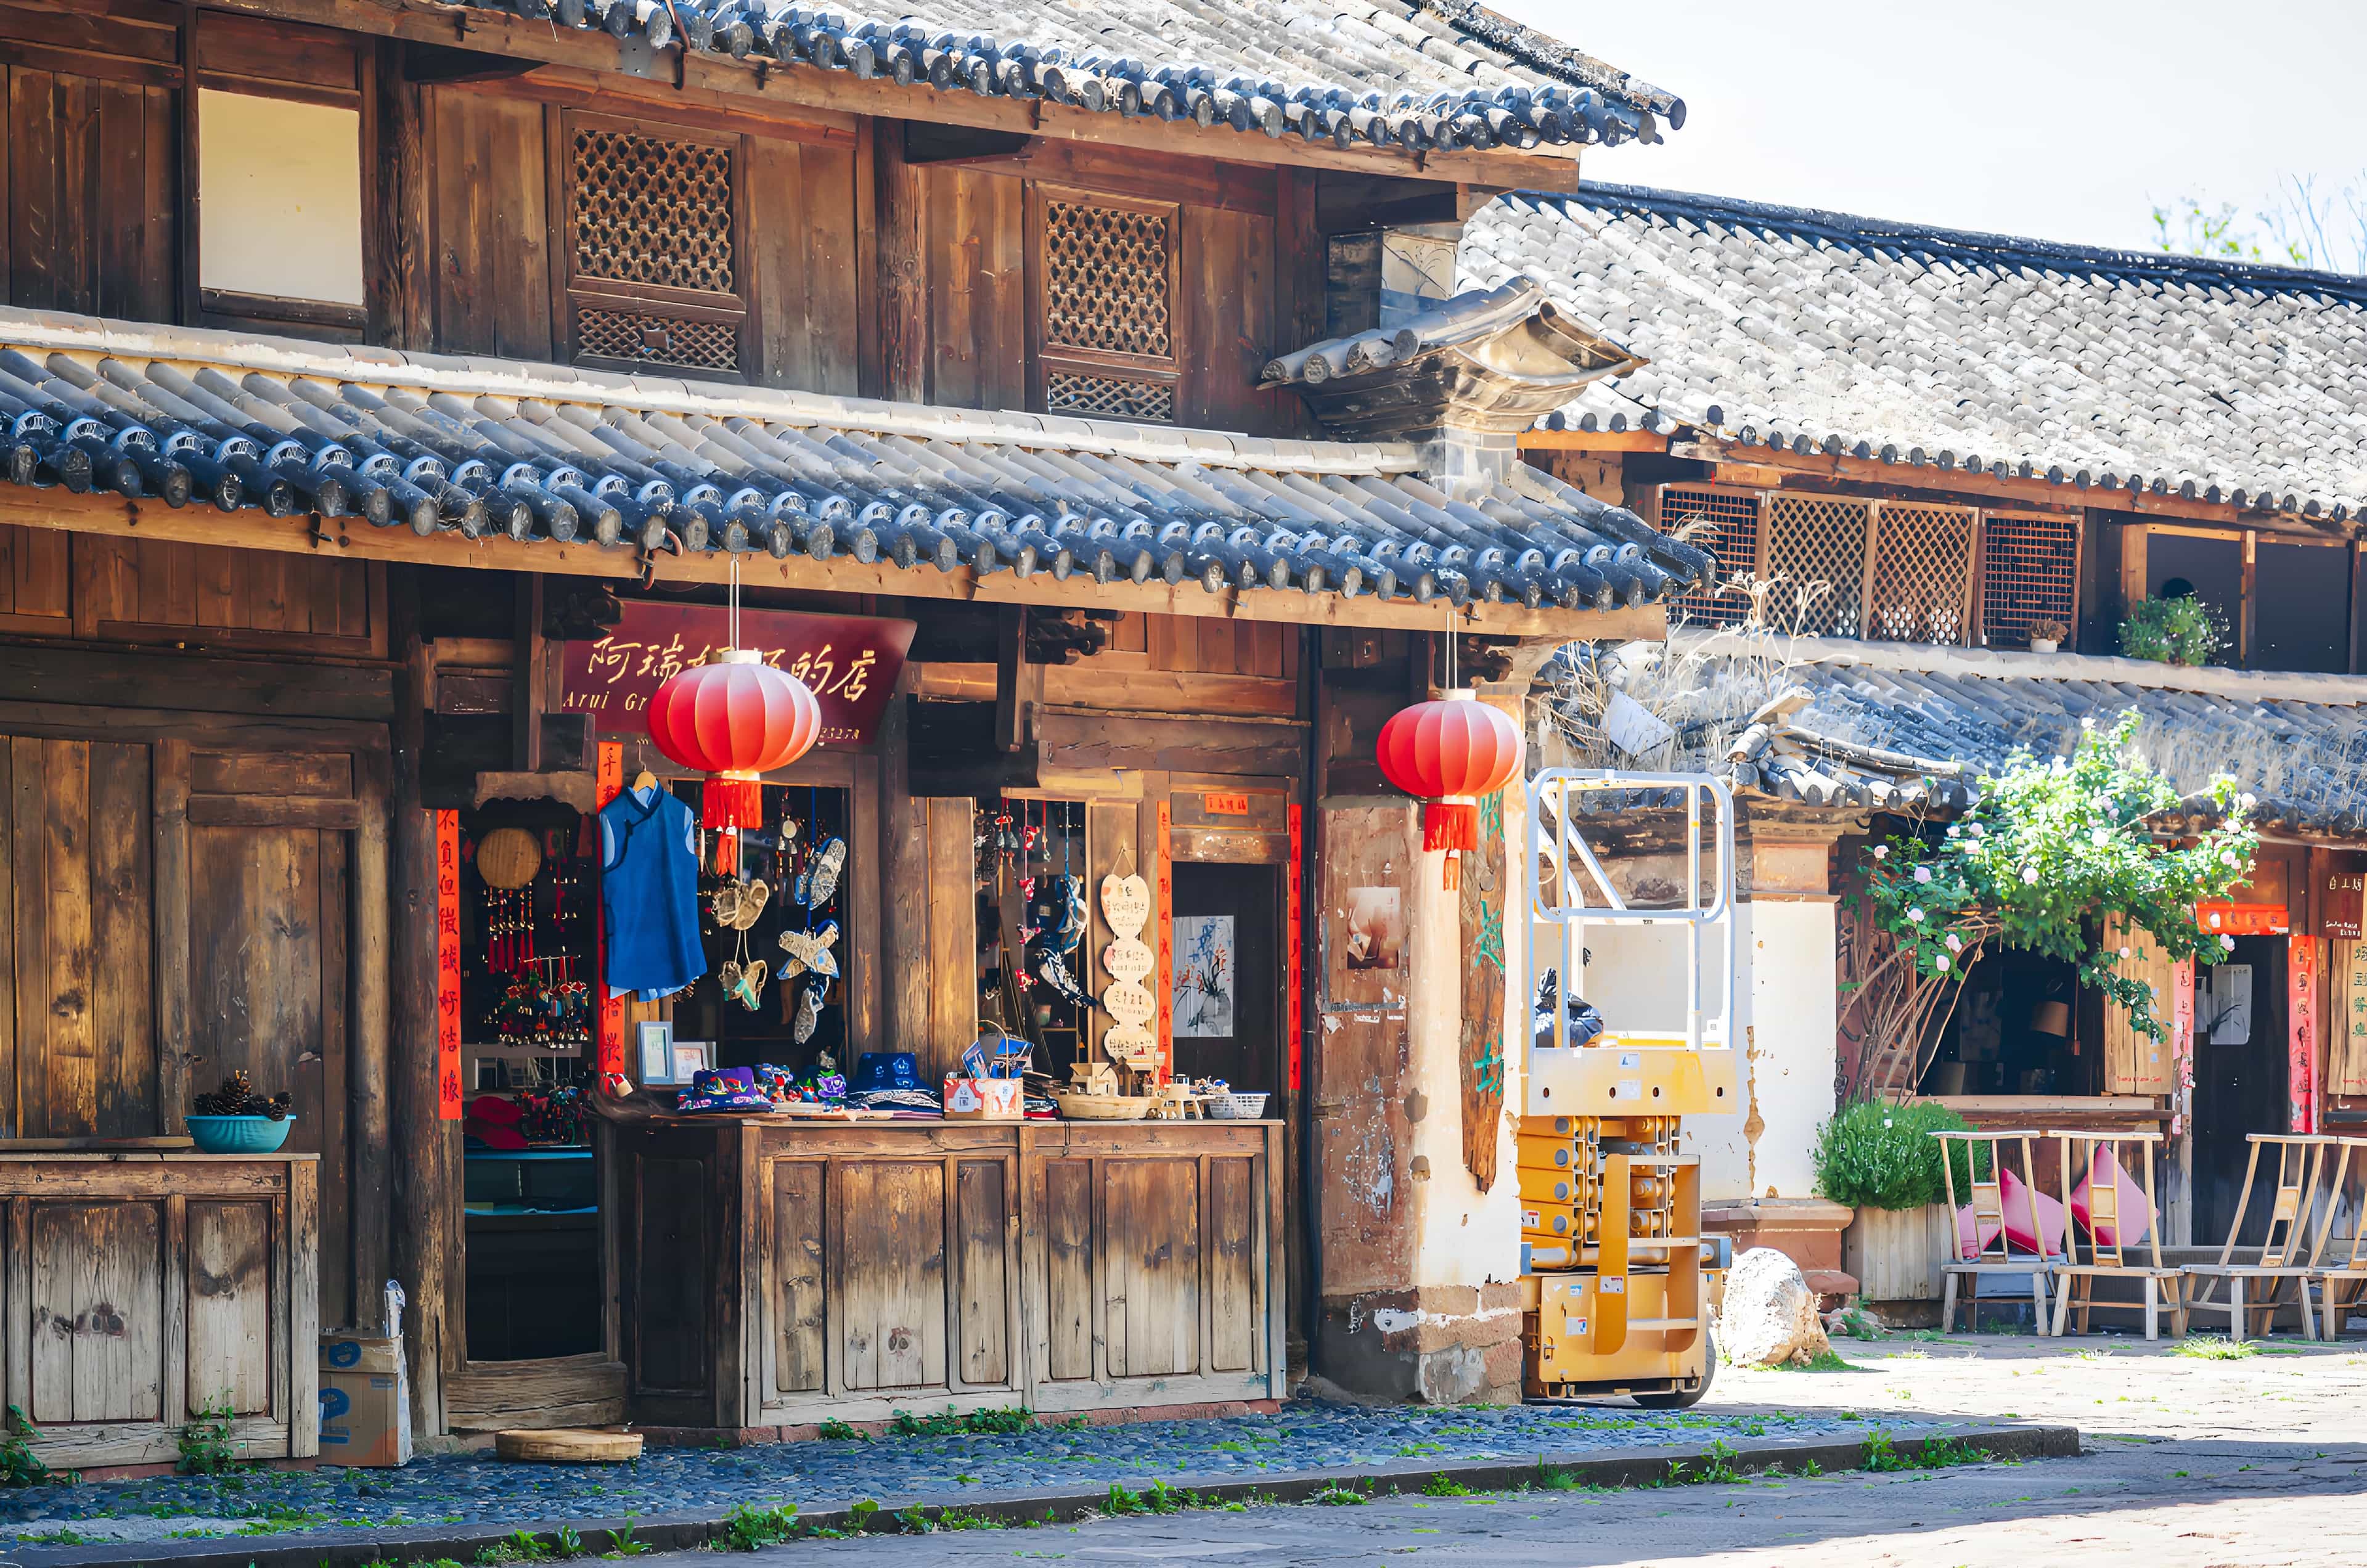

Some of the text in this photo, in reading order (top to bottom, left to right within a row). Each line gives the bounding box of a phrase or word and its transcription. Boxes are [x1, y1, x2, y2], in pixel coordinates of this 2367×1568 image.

[588, 633, 876, 702] 阿瑞的店
[562, 690, 610, 709] Arui
